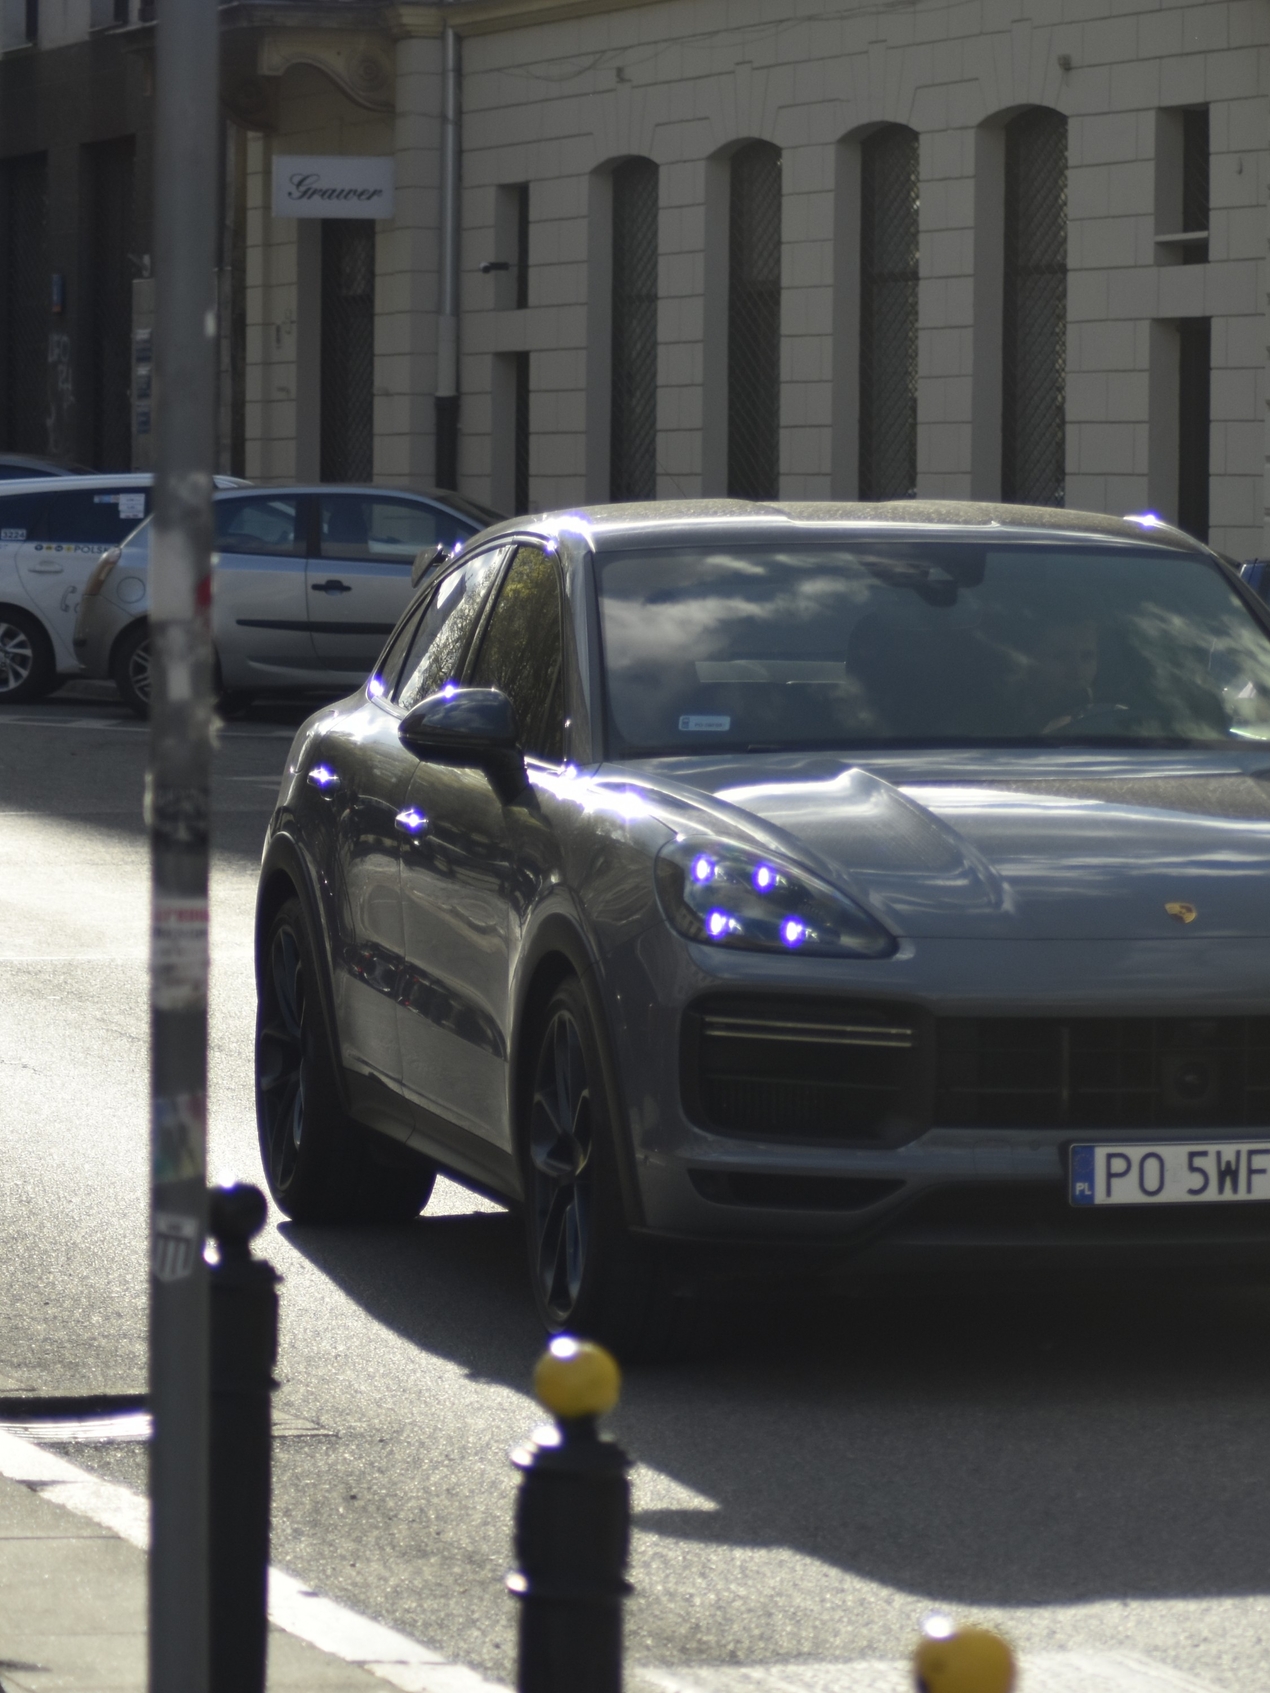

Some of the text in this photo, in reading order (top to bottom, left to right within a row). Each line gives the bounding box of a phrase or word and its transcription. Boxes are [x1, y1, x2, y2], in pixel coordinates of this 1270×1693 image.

[287, 172, 383, 201] Grawer
[1075, 1182, 1093, 1195] PL
[1104, 1151, 1166, 1198] PO
